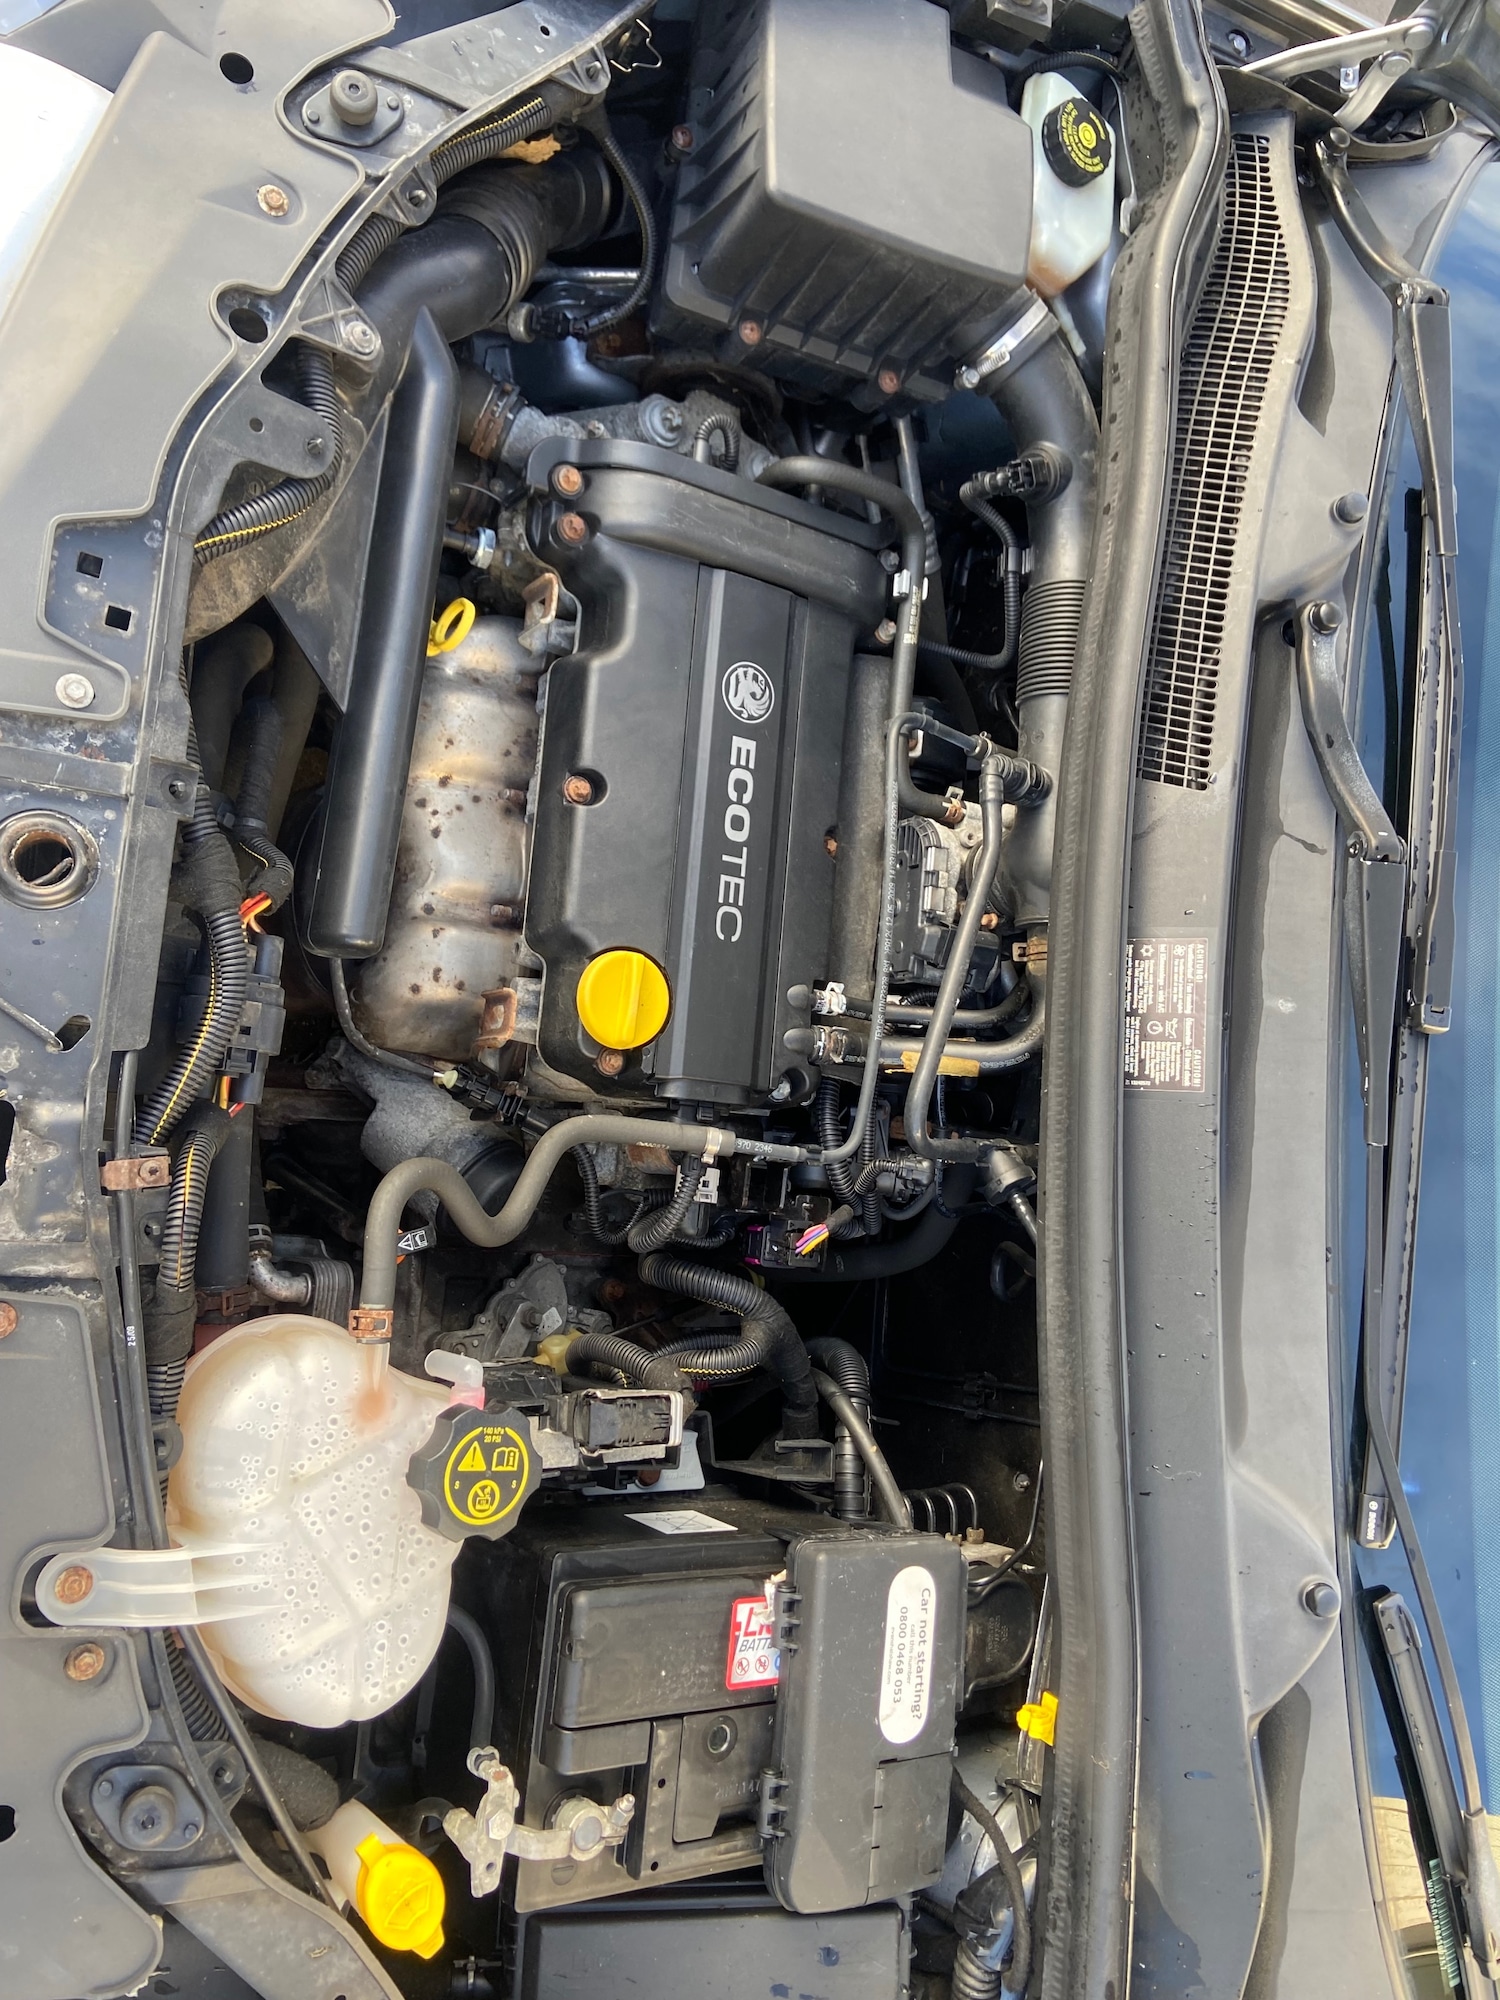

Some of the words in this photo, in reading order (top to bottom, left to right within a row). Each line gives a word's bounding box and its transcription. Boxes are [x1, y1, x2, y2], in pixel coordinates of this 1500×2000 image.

[715, 735, 757, 943] ECOTEC
[1196, 944, 1205, 983] ACHTUNG!
[1193, 1049, 1202, 1087] CAUTION!
[735, 1140, 752, 1150] 970
[754, 1142, 773, 1153] 2346
[454, 1480, 460, 1489] S
[511, 1480, 516, 1489] S
[921, 1588, 932, 1614] Car
[898, 1606, 909, 1639] 0800
[918, 1620, 927, 1646] not
[895, 1643, 906, 1675] 0468
[893, 1679, 903, 1704] 053
[911, 1651, 926, 1720] starting?
